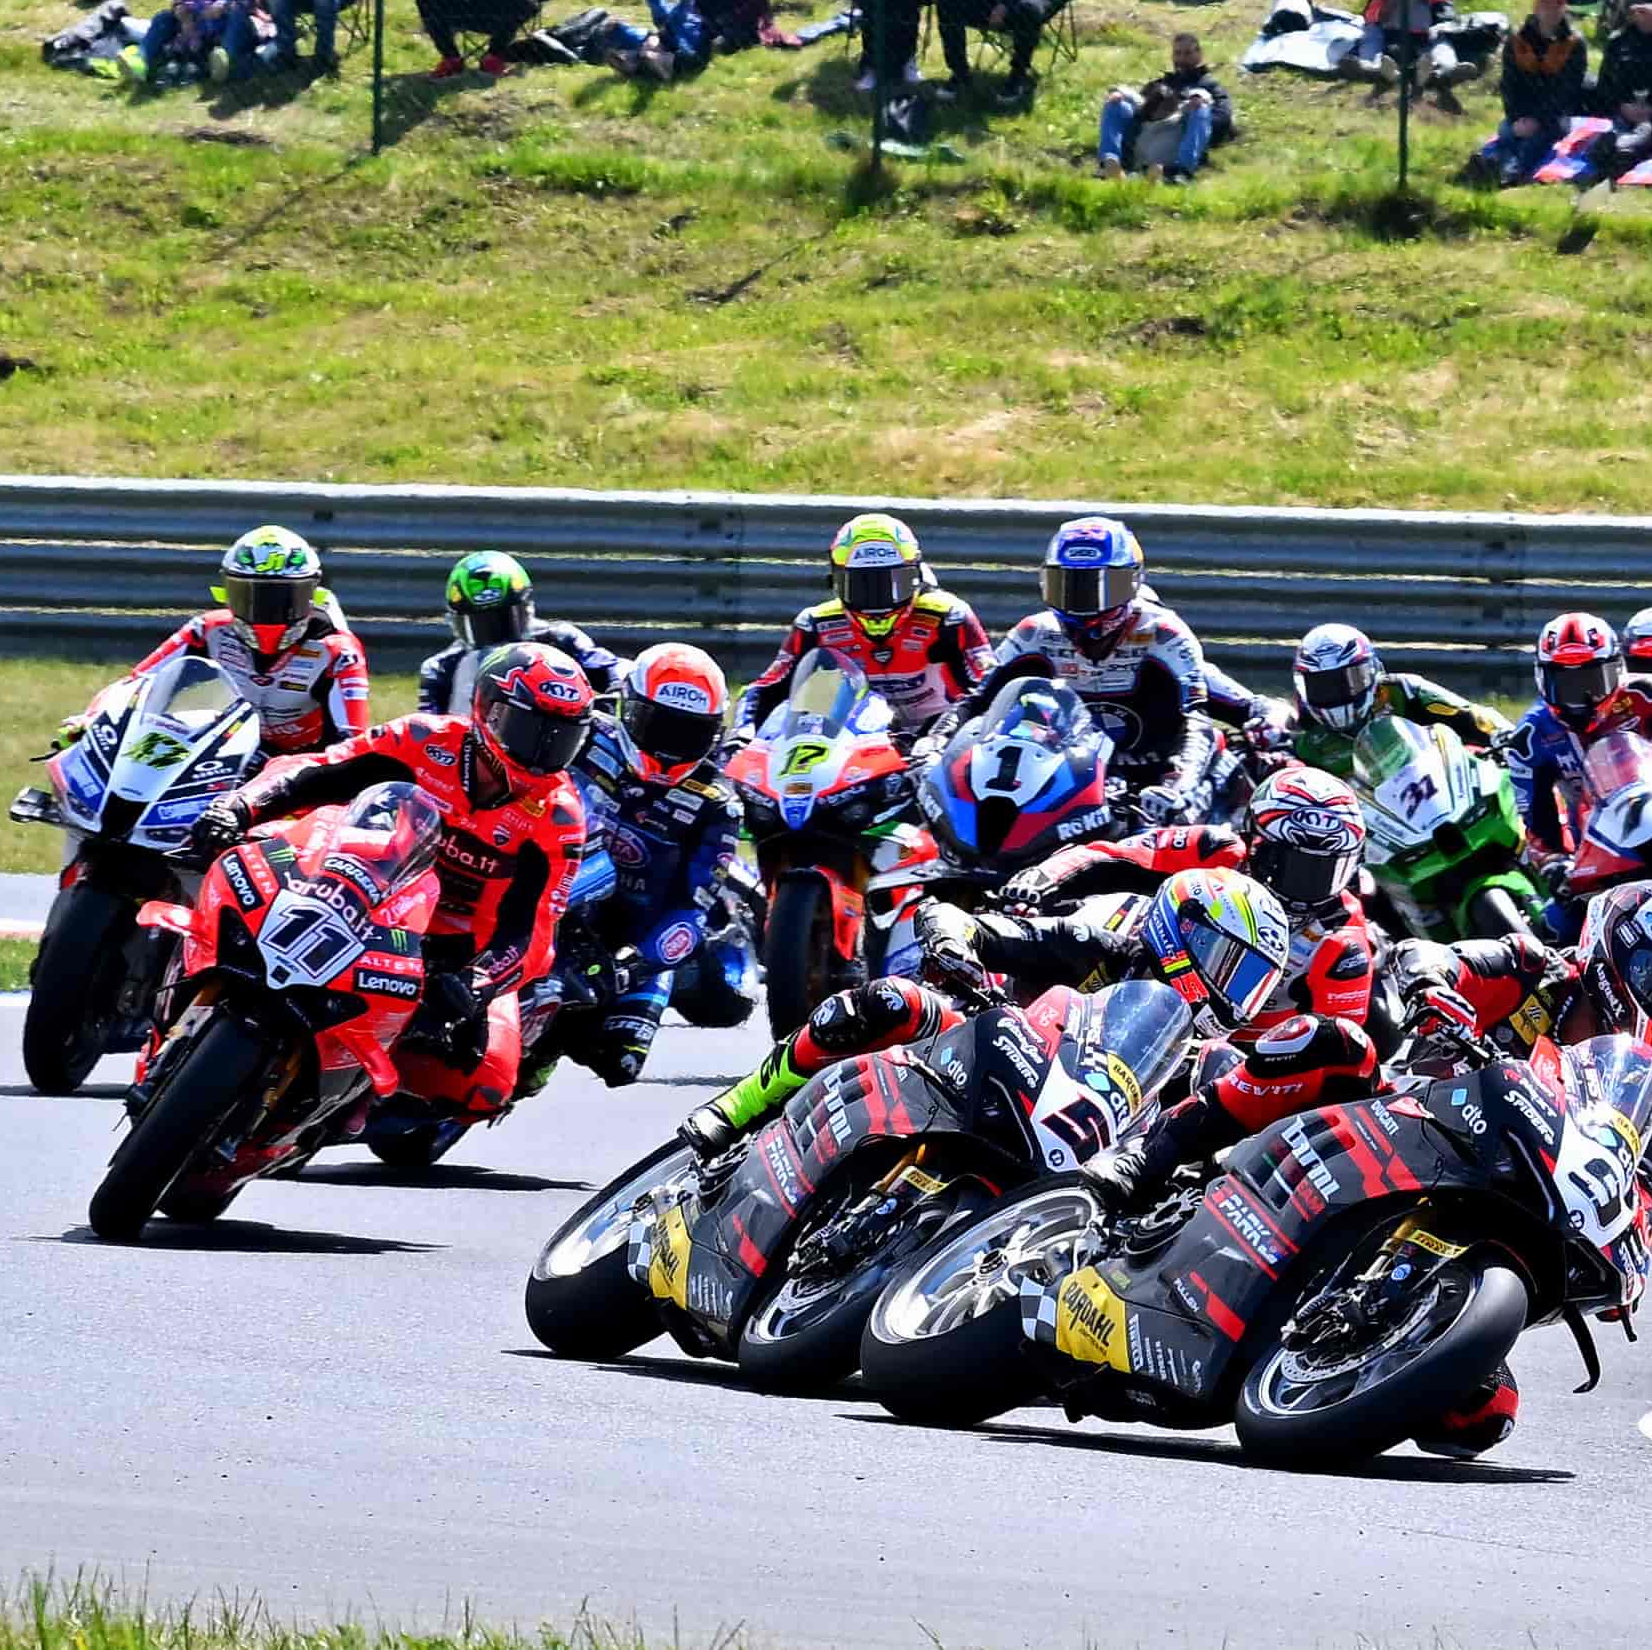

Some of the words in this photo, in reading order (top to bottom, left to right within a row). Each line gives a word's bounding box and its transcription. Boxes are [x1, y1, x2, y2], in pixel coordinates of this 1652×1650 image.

[853, 547, 898, 561] AIROH
[540, 681, 581, 701] KYT
[658, 684, 707, 704] AIROH
[985, 745, 1023, 793] 1
[1401, 773, 1440, 821] 31
[222, 853, 257, 906] Lenovo
[323, 857, 383, 904] CARRERA
[260, 904, 355, 979] 11
[357, 971, 418, 997] Lenovo
[948, 1058, 968, 1085] dto
[1110, 1090, 1135, 1137] dt
[1369, 1099, 1399, 1136] DUCATI
[1461, 1102, 1488, 1135] dto
[1063, 1280, 1117, 1348] BARDAHL
